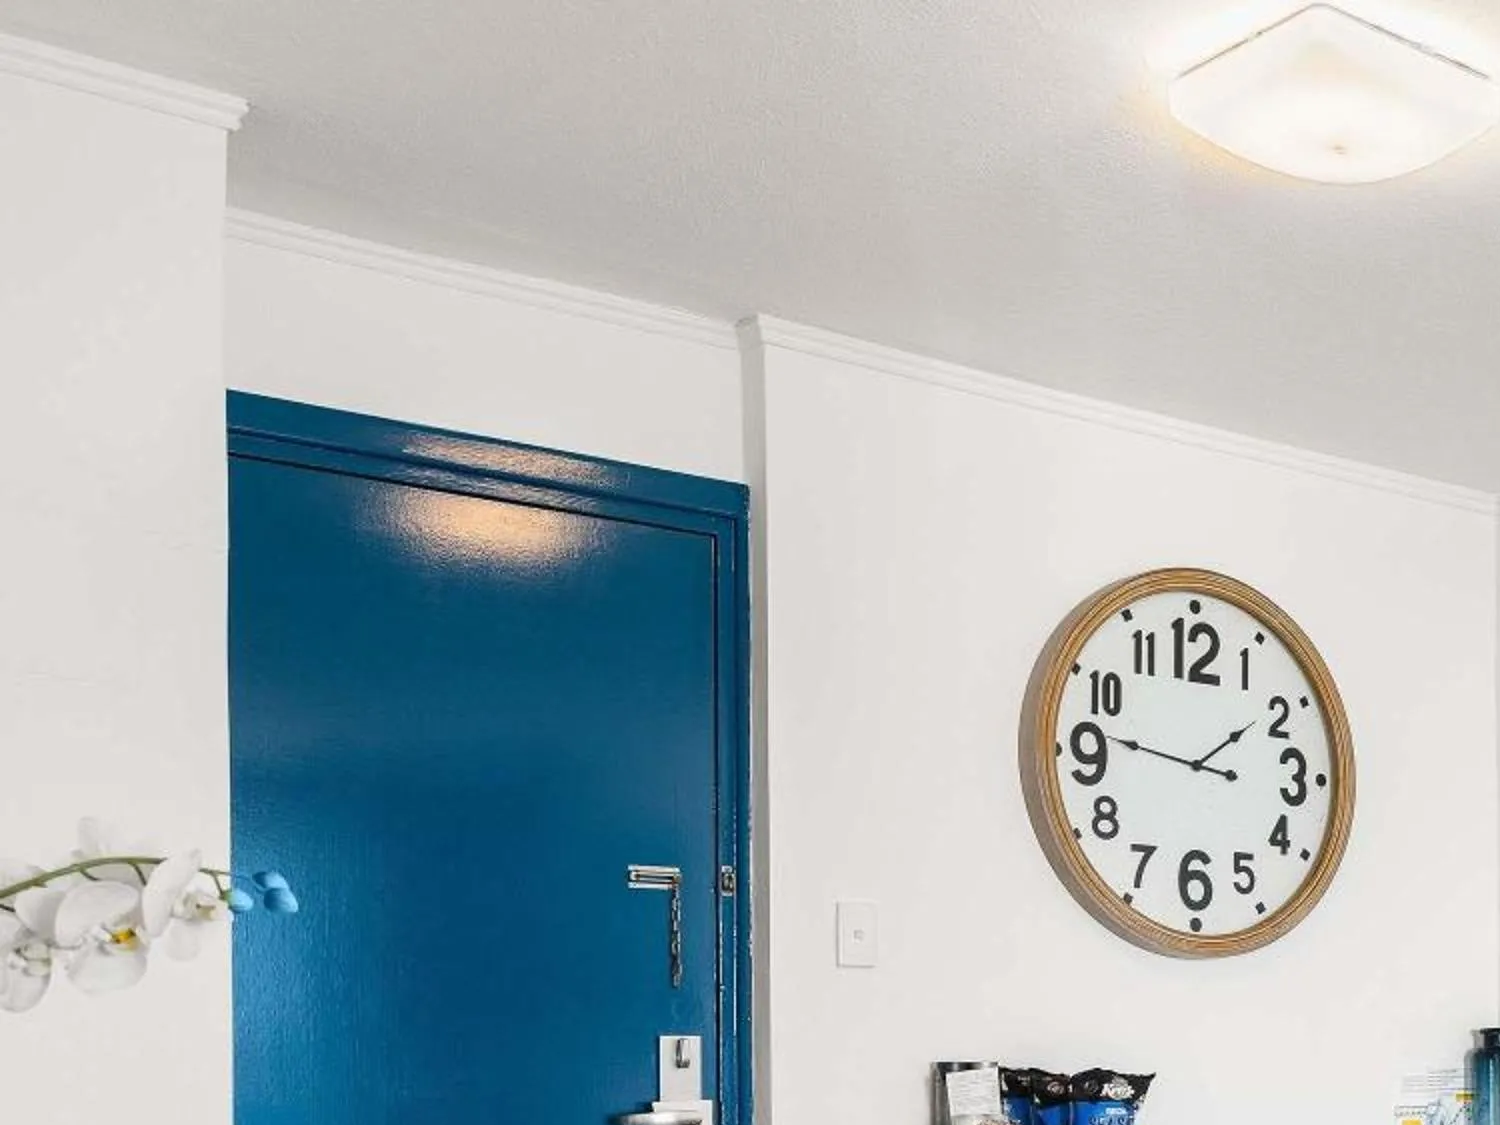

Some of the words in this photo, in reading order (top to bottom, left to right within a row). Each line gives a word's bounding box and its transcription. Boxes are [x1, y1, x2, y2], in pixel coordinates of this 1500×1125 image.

[1132, 629, 1155, 677] 11
[1172, 617, 1221, 686] 12
[1239, 647, 1250, 691] 1
[1089, 669, 1122, 717] 10
[1267, 695, 1291, 740] 2
[1069, 721, 1108, 787] 9
[1279, 747, 1307, 807] 3
[1091, 795, 1120, 841] 8
[1268, 814, 1291, 856] 4
[1130, 843, 1158, 889] 7
[1178, 849, 1213, 912] 6
[1233, 851, 1256, 895] 5
